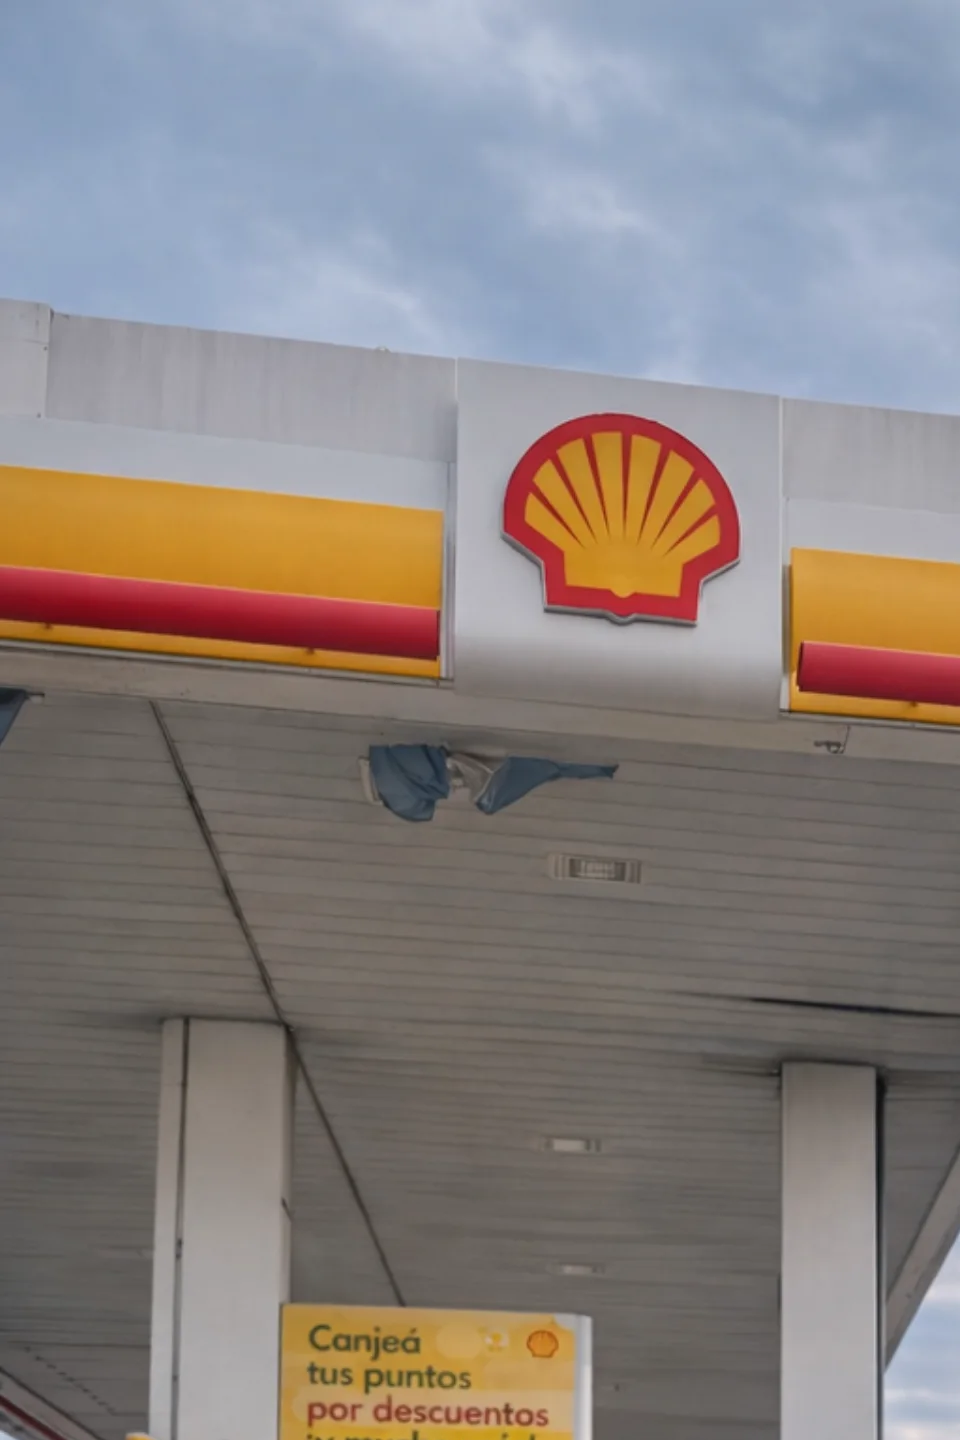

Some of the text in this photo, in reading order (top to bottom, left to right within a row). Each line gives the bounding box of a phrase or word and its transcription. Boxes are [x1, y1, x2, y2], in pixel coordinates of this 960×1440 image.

[308, 1324, 421, 1361] Canjeá
[307, 1361, 472, 1394] tus puntos
[307, 1394, 549, 1428] por descuentos
